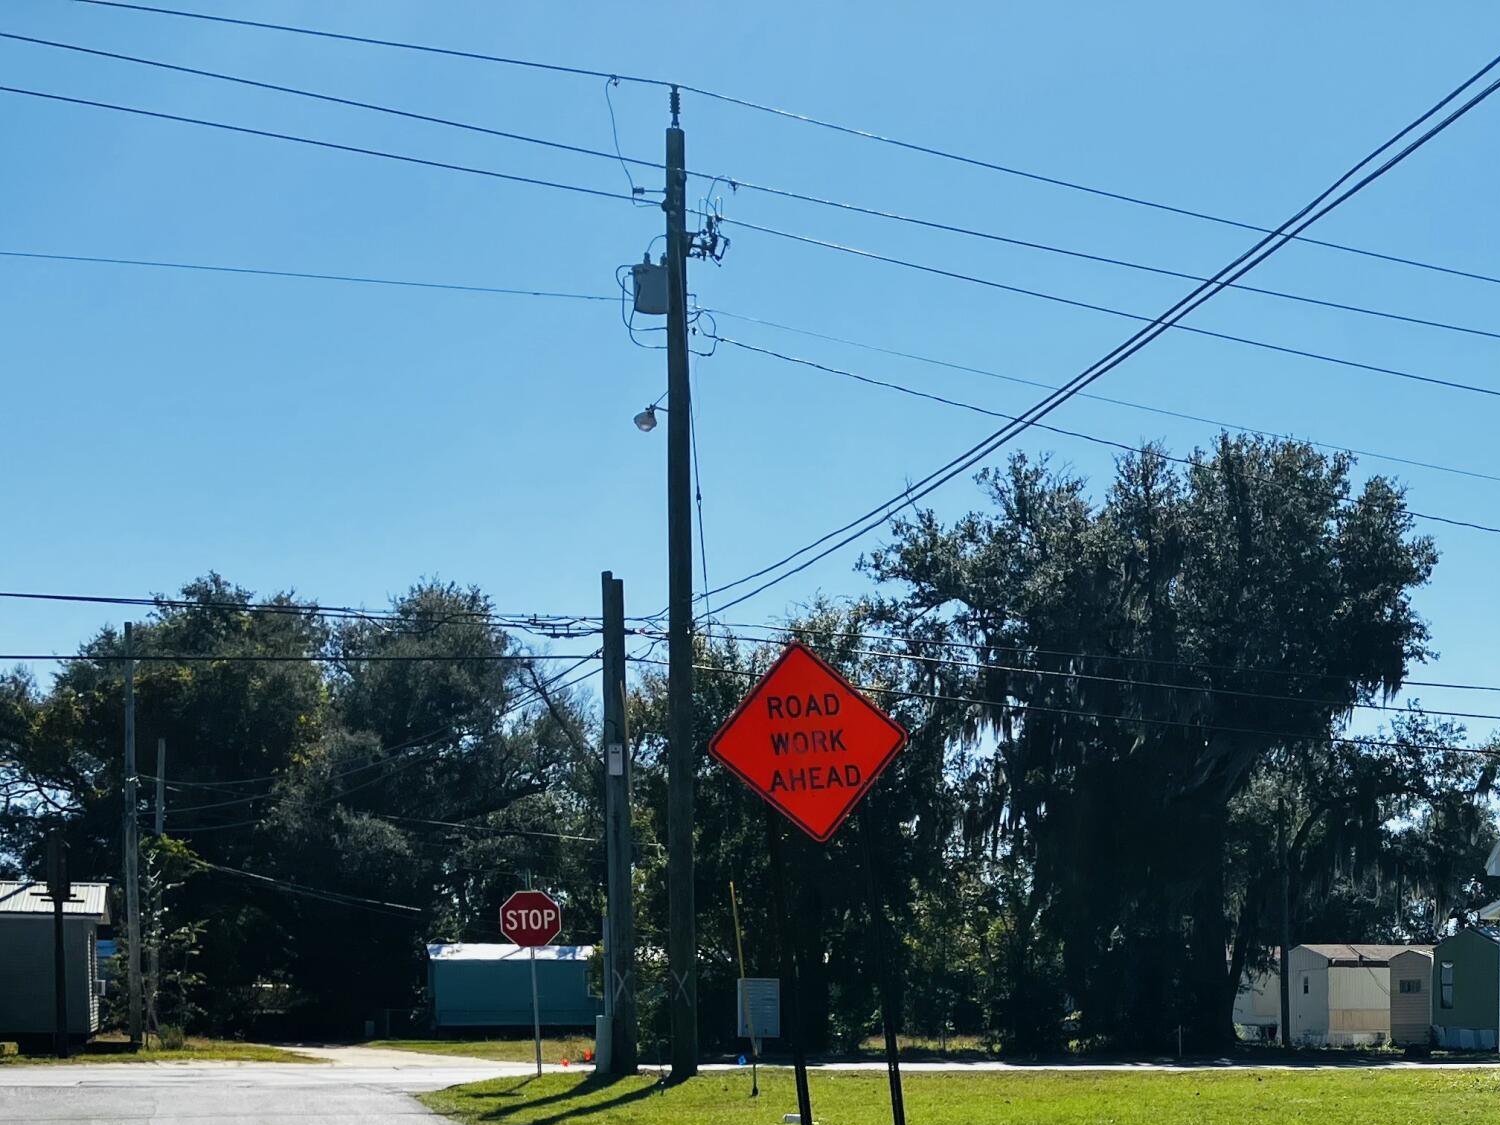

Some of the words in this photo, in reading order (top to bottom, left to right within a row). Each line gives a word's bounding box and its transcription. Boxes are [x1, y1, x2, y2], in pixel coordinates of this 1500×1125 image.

[767, 693, 840, 720] ROAD
[771, 729, 847, 756] WORK
[770, 764, 861, 792] AHEAD
[505, 909, 556, 931] STOP
